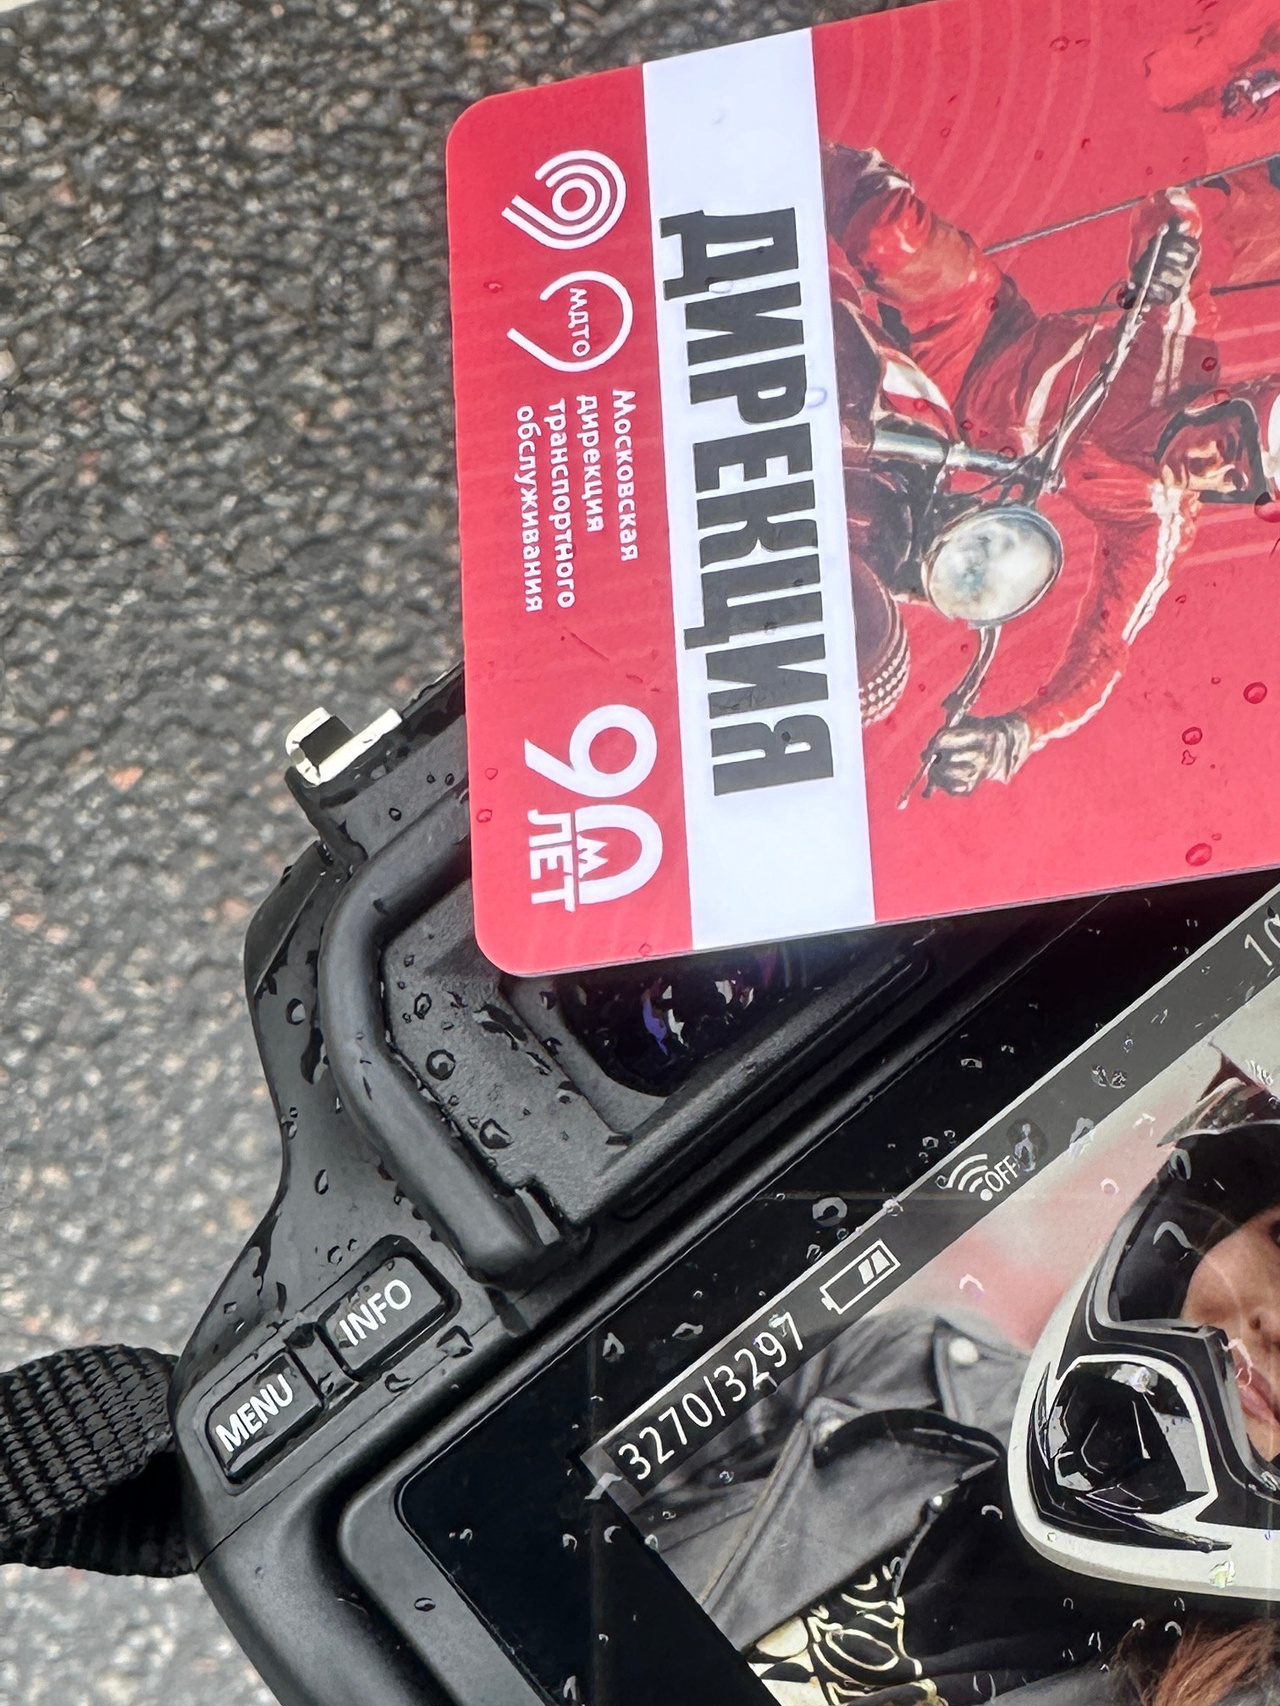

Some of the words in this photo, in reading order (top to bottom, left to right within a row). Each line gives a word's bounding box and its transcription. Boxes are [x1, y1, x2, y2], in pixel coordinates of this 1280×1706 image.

[568, 287, 591, 357] МДТО
[514, 405, 543, 612] обслуживания
[544, 397, 576, 608] транспортного
[576, 394, 604, 533] дирекция
[612, 389, 639, 562] Московская
[659, 206, 835, 797] ДИРЕКЦИЯ
[524, 704, 664, 905] 90
[527, 808, 576, 912] ЛЕТ
[985, 1154, 1018, 1193] OFF
[339, 1279, 412, 1346] INFO
[215, 1373, 293, 1452] MENU
[618, 1311, 805, 1480] 3270/3297
